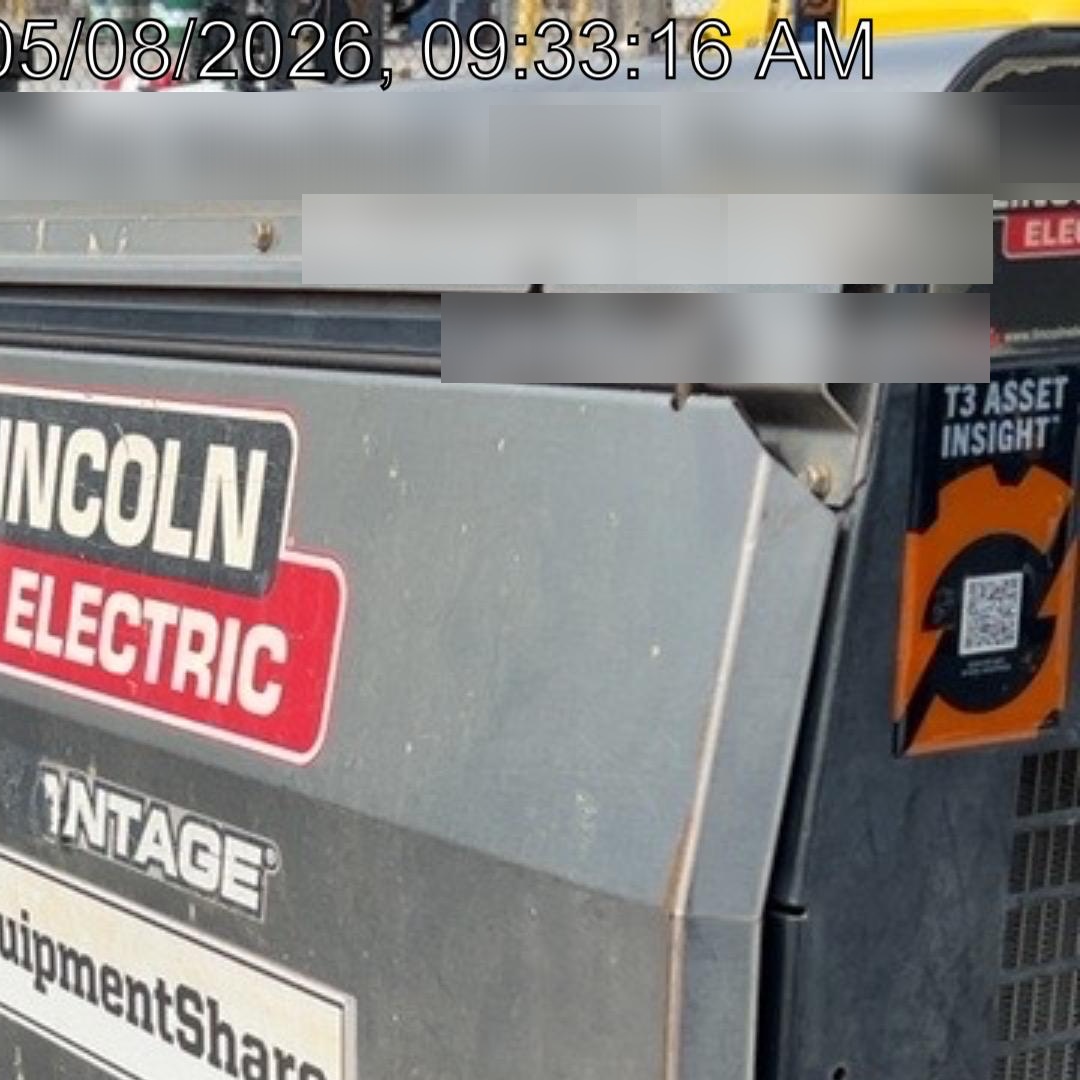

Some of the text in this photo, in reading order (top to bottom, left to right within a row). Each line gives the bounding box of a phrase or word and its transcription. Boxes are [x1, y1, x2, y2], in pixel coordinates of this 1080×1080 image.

[1024, 217, 1080, 247] ELE
[944, 375, 1069, 419] T3 ASSET
[940, 415, 1053, 459] INSIGHT
[3, 566, 289, 716] ELECTRIC
